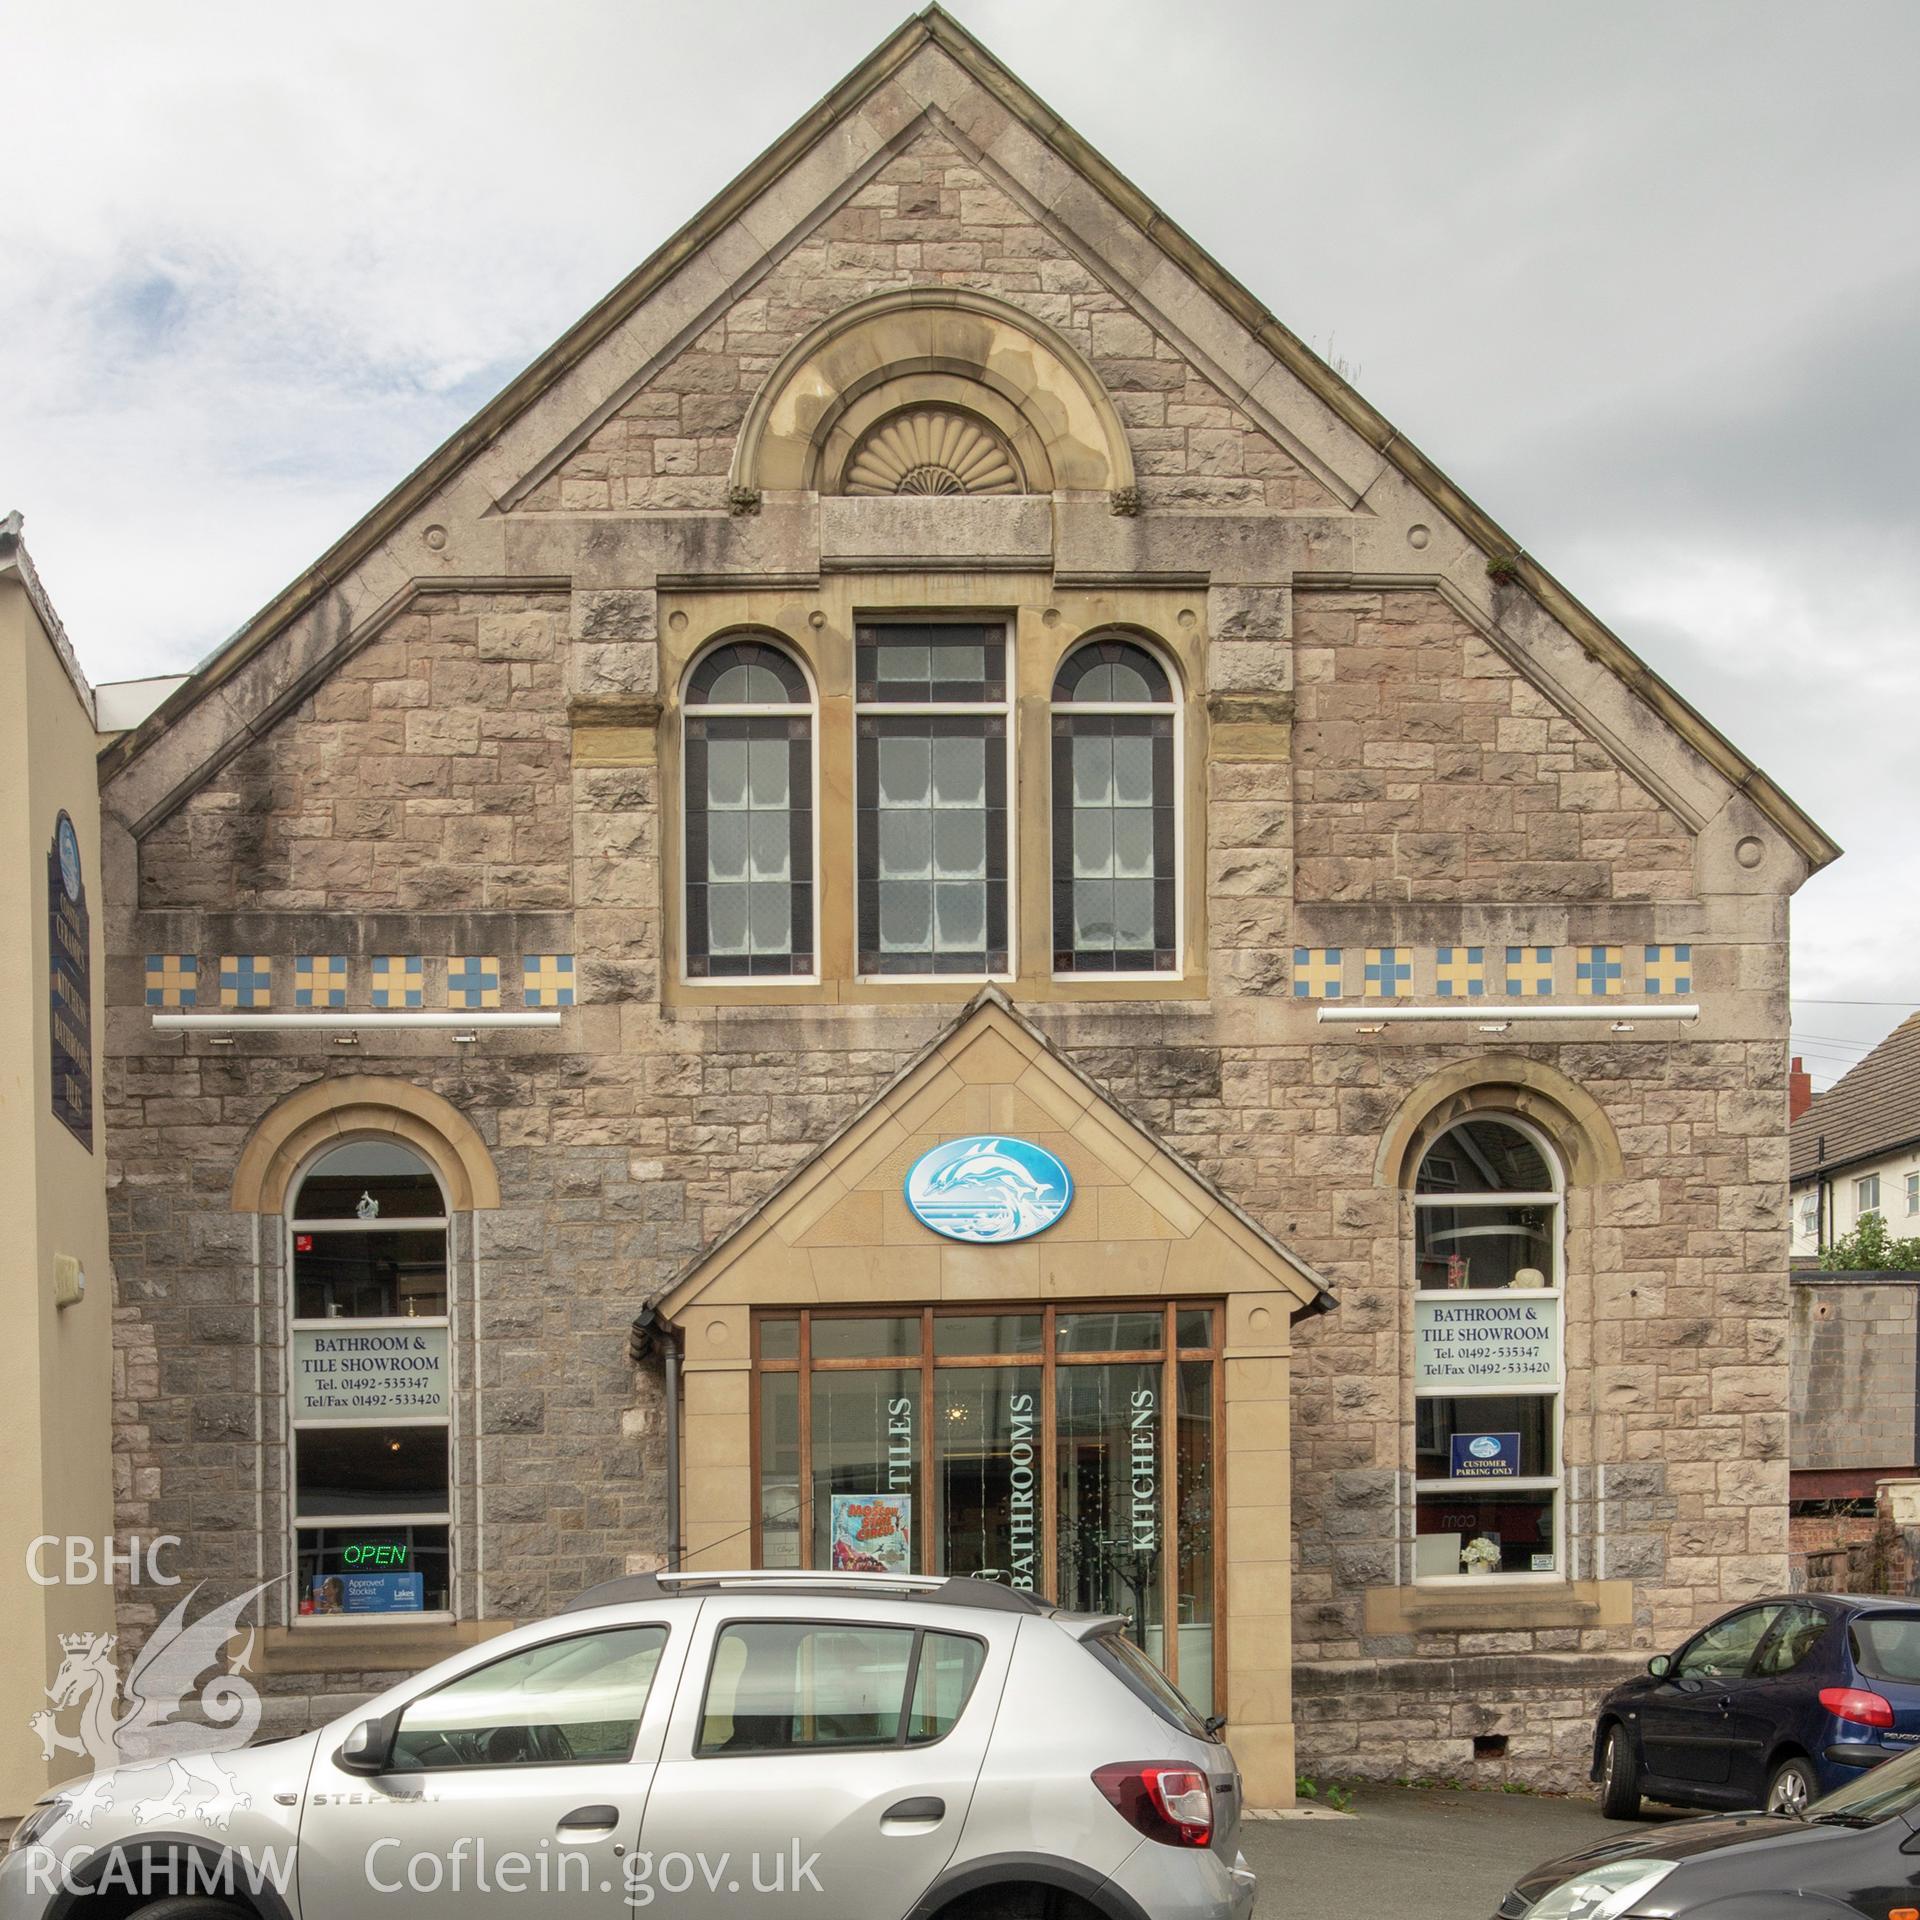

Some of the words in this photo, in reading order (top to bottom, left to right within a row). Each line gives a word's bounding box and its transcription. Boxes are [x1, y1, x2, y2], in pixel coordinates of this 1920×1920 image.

[1433, 1307, 1522, 1322] BATHROOM
[1525, 1307, 1538, 1320] &
[1421, 1328, 1455, 1342] TILE
[1458, 1326, 1550, 1341] SHOWROOM
[315, 1336, 409, 1352] BATHROOM
[413, 1336, 426, 1350] &
[1433, 1347, 1455, 1359] Tel.
[302, 1359, 338, 1373] TILE
[340, 1356, 440, 1372] SHOWROOM
[1423, 1364, 1466, 1376] Tel/Fax
[315, 1378, 338, 1391] Tel.
[304, 1395, 349, 1408] Tel/Fax
[888, 1397, 912, 1490] TILES
[1131, 1389, 1155, 1551] KITCHENS
[1463, 1459, 1507, 1468] CUSTOMER
[1456, 1468, 1491, 1476] PARKING
[1492, 1467, 1514, 1475] ONLY
[1010, 1393, 1034, 1592] BATHROOMS
[848, 1503, 898, 1517] MOSCOW
[862, 1516, 892, 1528] STATE
[856, 1525, 895, 1541] CIRCUS
[344, 1545, 408, 1564] OPEN
[348, 1578, 385, 1588] Approved
[348, 1587, 377, 1596] Stockist
[393, 1589, 415, 1598] Lakes
[313, 1790, 441, 1806] STEPWAY
